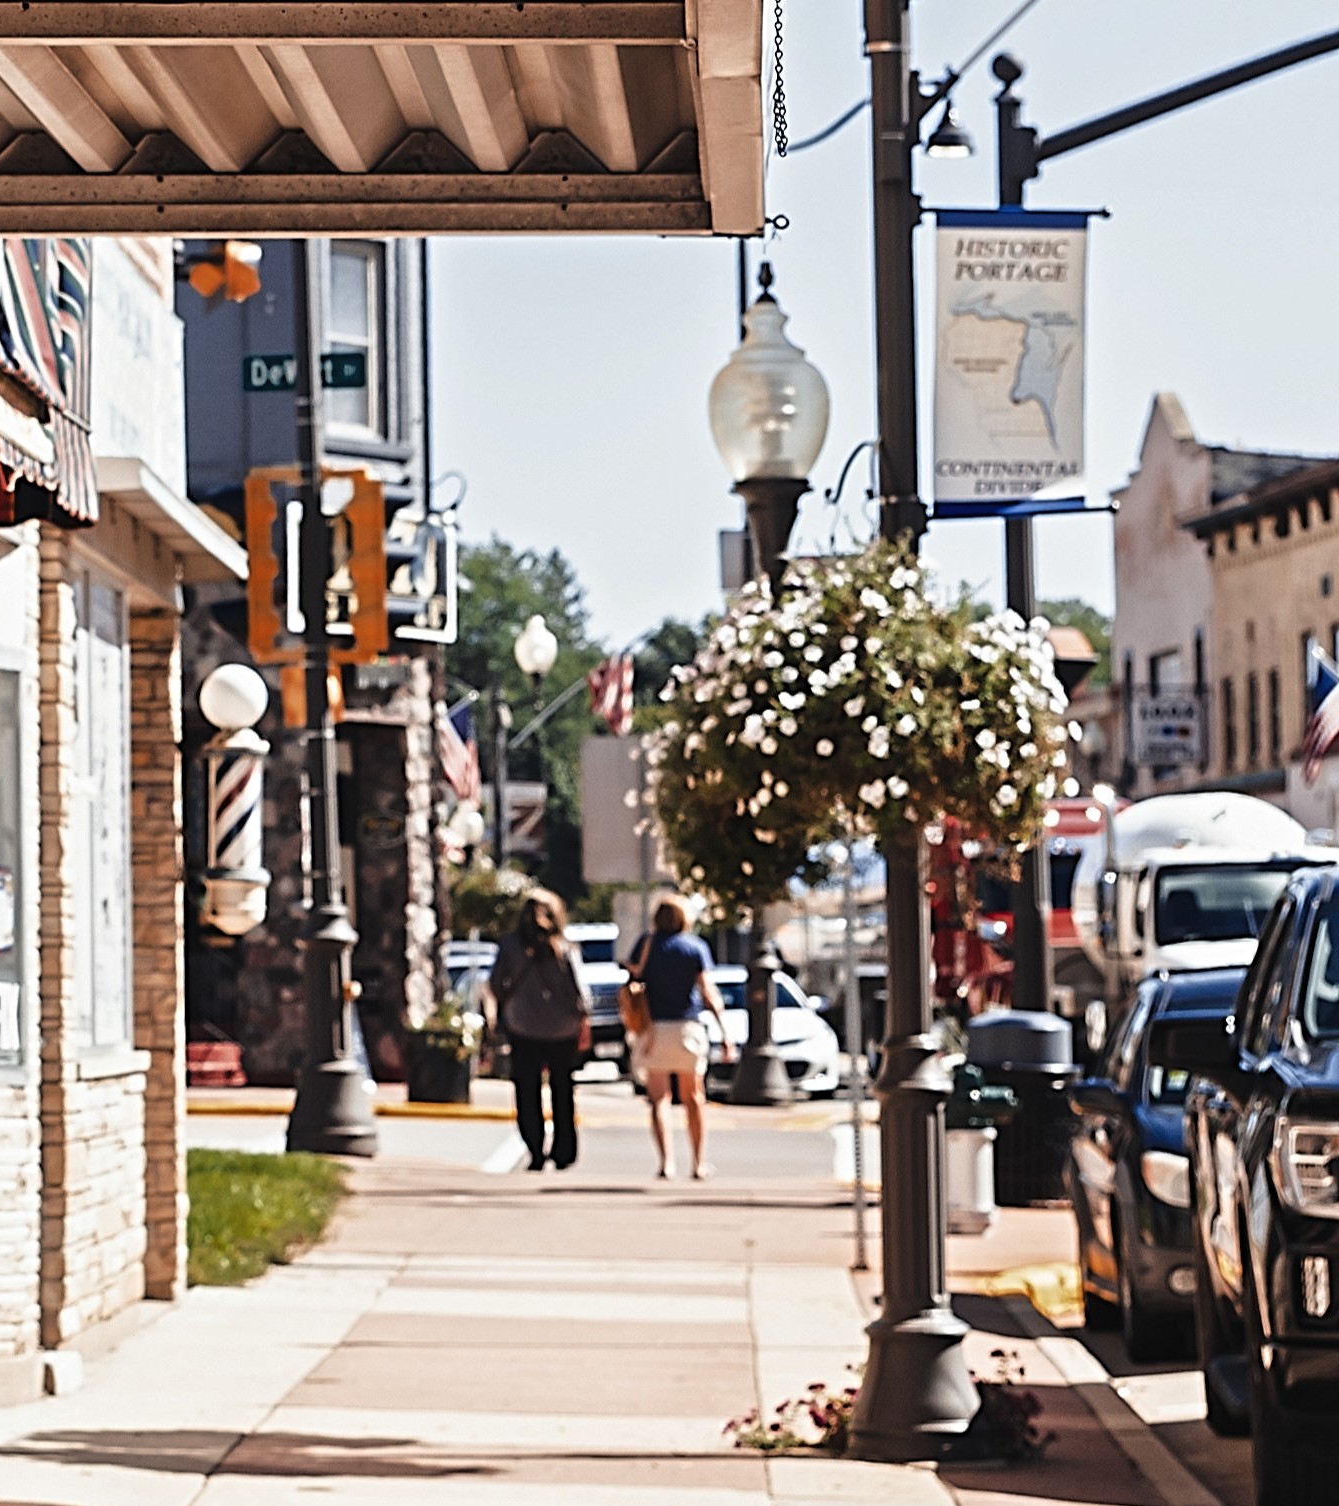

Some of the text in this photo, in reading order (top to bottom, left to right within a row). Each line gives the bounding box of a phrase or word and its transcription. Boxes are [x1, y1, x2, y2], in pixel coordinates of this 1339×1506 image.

[954, 237, 1071, 259] HISTORIC
[954, 260, 1069, 283] PORTAGE
[935, 457, 1080, 477] CONTINENTAL
